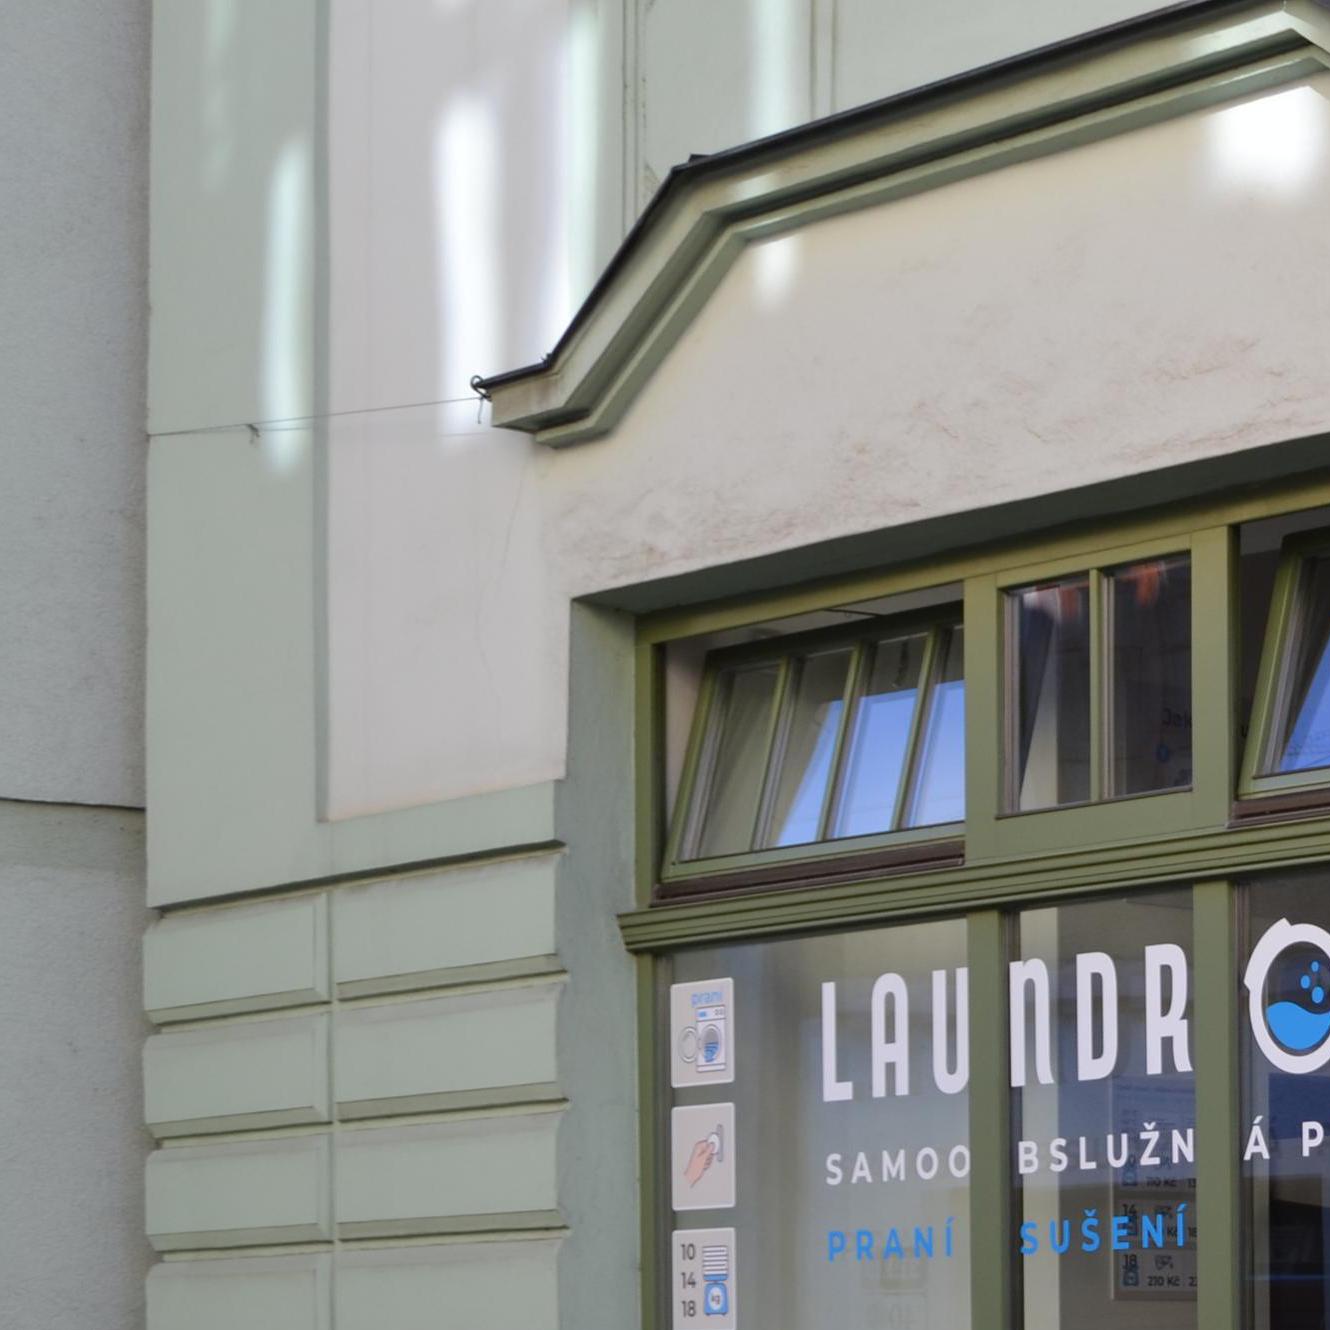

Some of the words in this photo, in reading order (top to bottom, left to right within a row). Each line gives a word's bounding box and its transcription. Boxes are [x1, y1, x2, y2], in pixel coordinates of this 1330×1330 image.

[827, 1215, 956, 1263] PRANÍ
[1019, 1203, 1188, 1256] SUŠENÍ
[680, 1243, 696, 1260] 10
[681, 1272, 696, 1289] 14
[681, 1300, 696, 1317] 18
